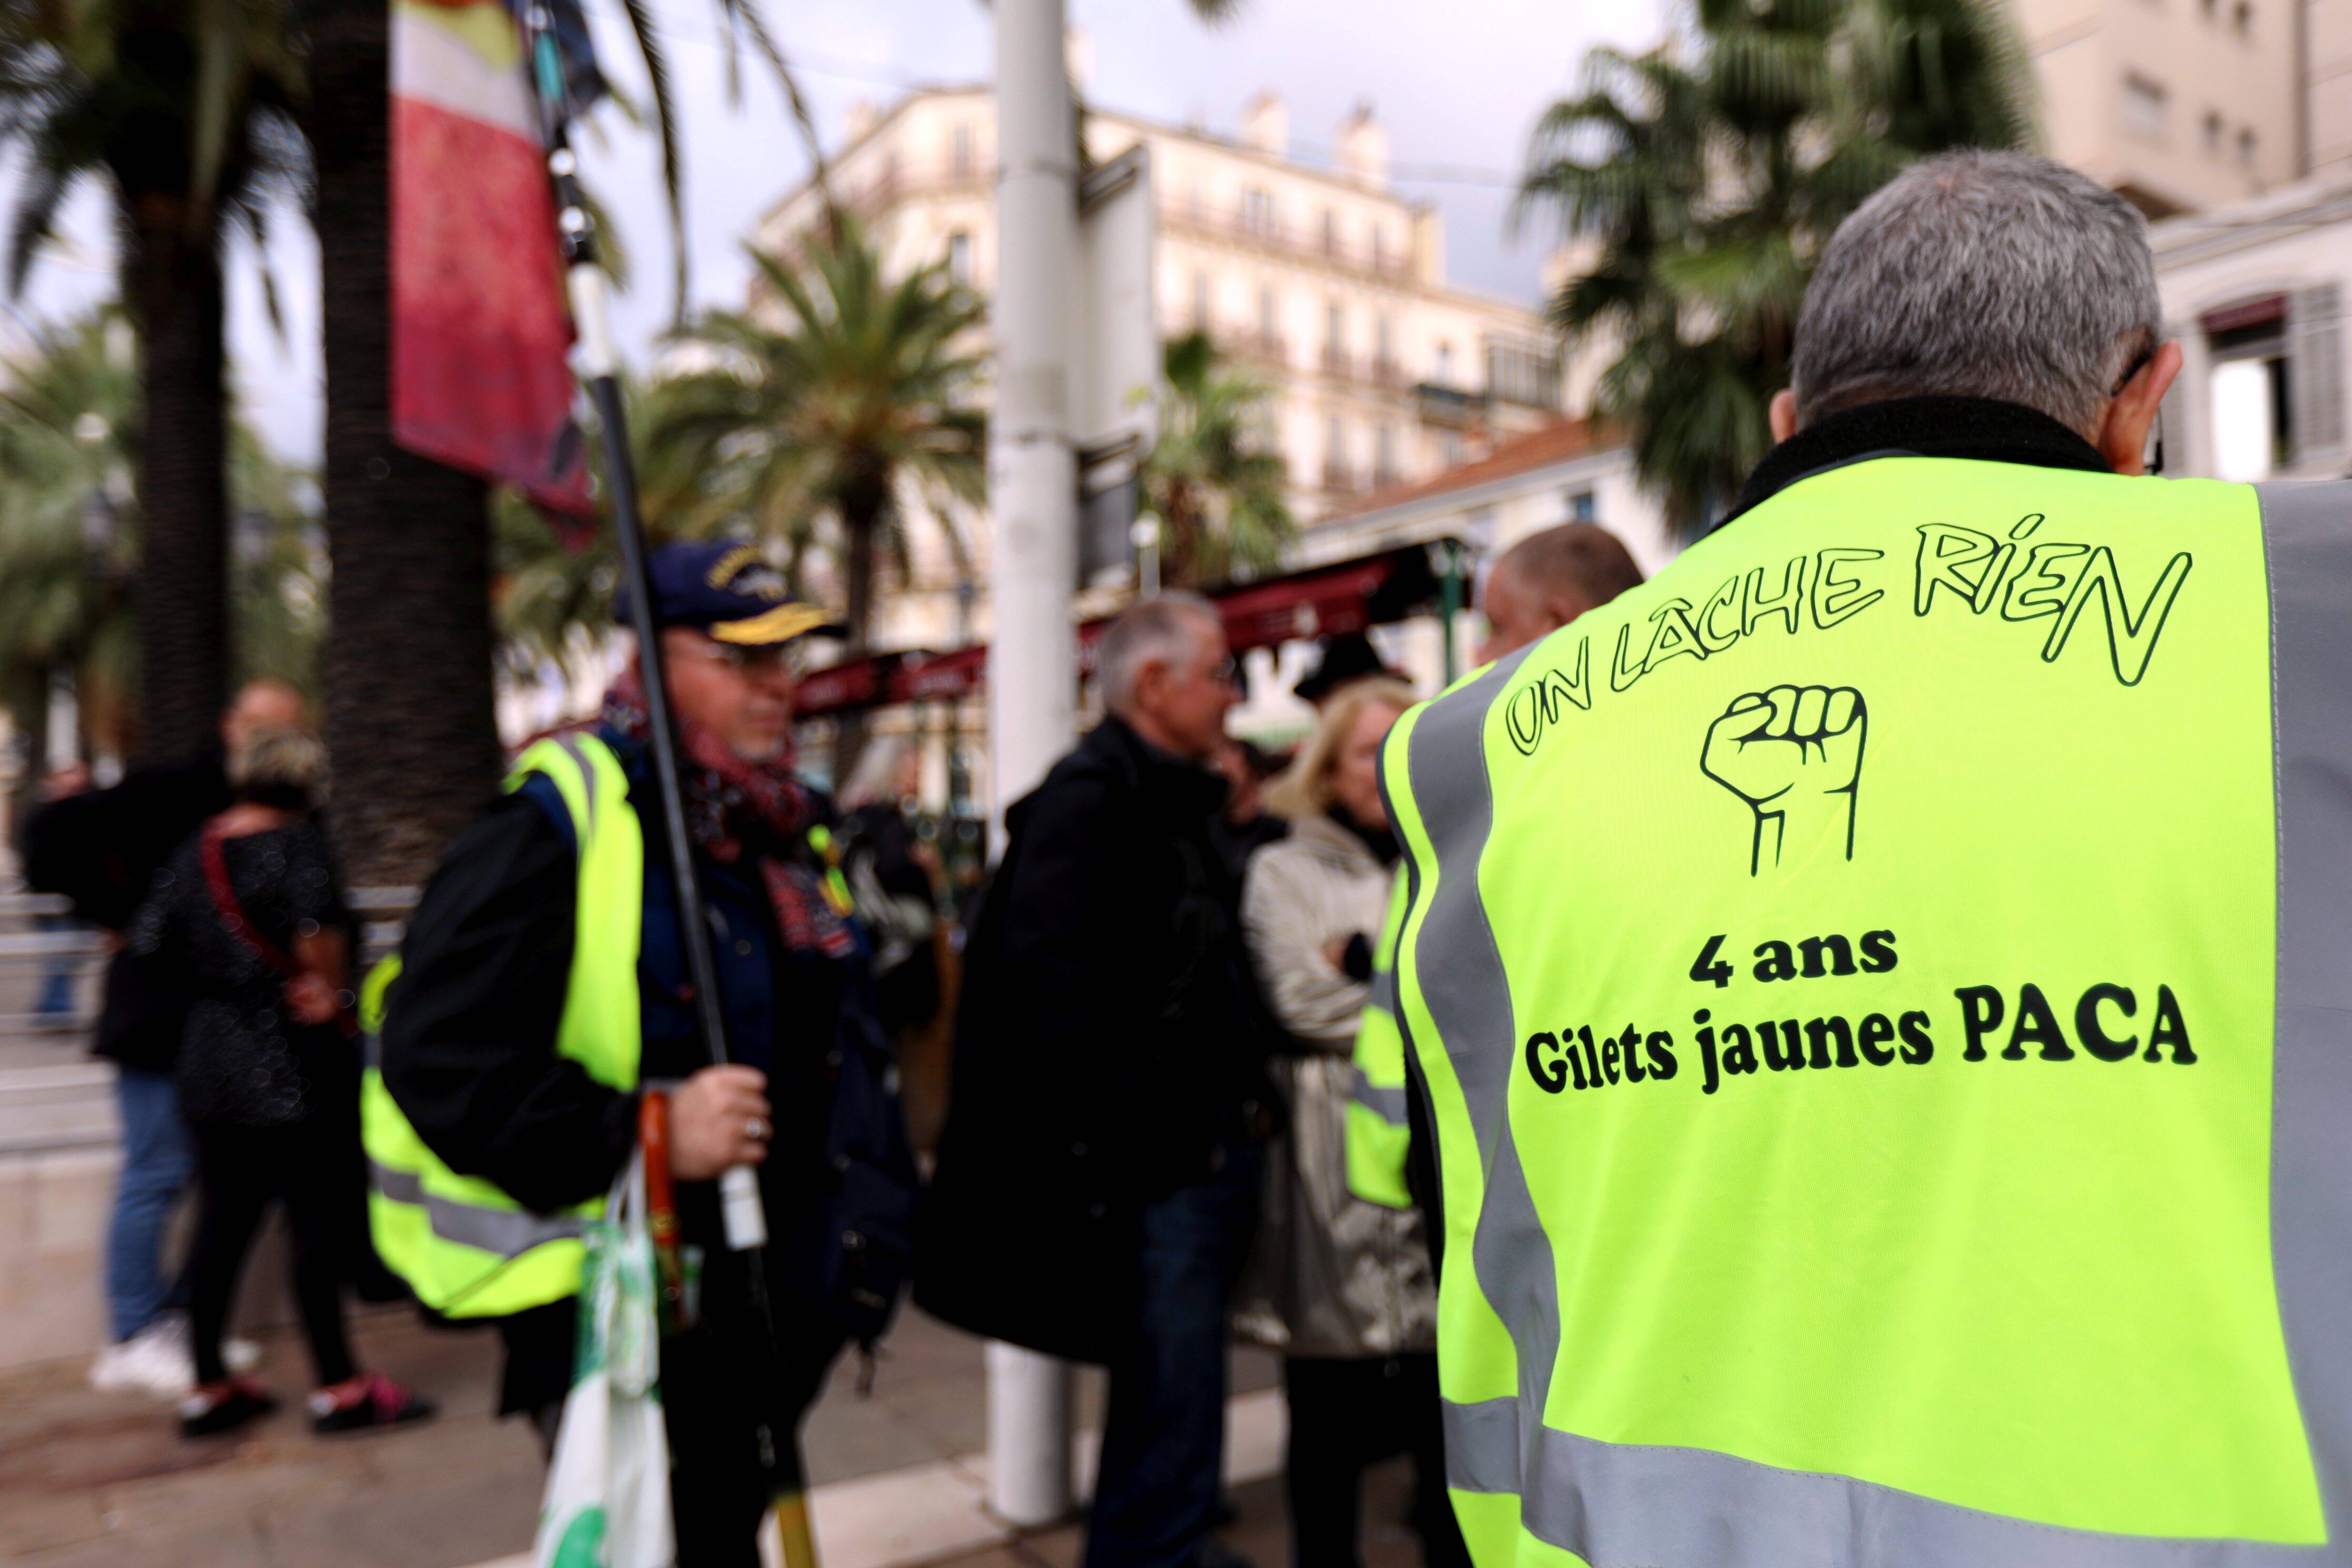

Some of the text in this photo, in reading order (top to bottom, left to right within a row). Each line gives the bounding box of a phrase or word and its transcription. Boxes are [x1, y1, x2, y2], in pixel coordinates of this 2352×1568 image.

[1506, 636, 1591, 756] ON
[1689, 929, 1898, 988] 4 ans
[1525, 983, 2197, 1095] Gilets jaunes PACA
